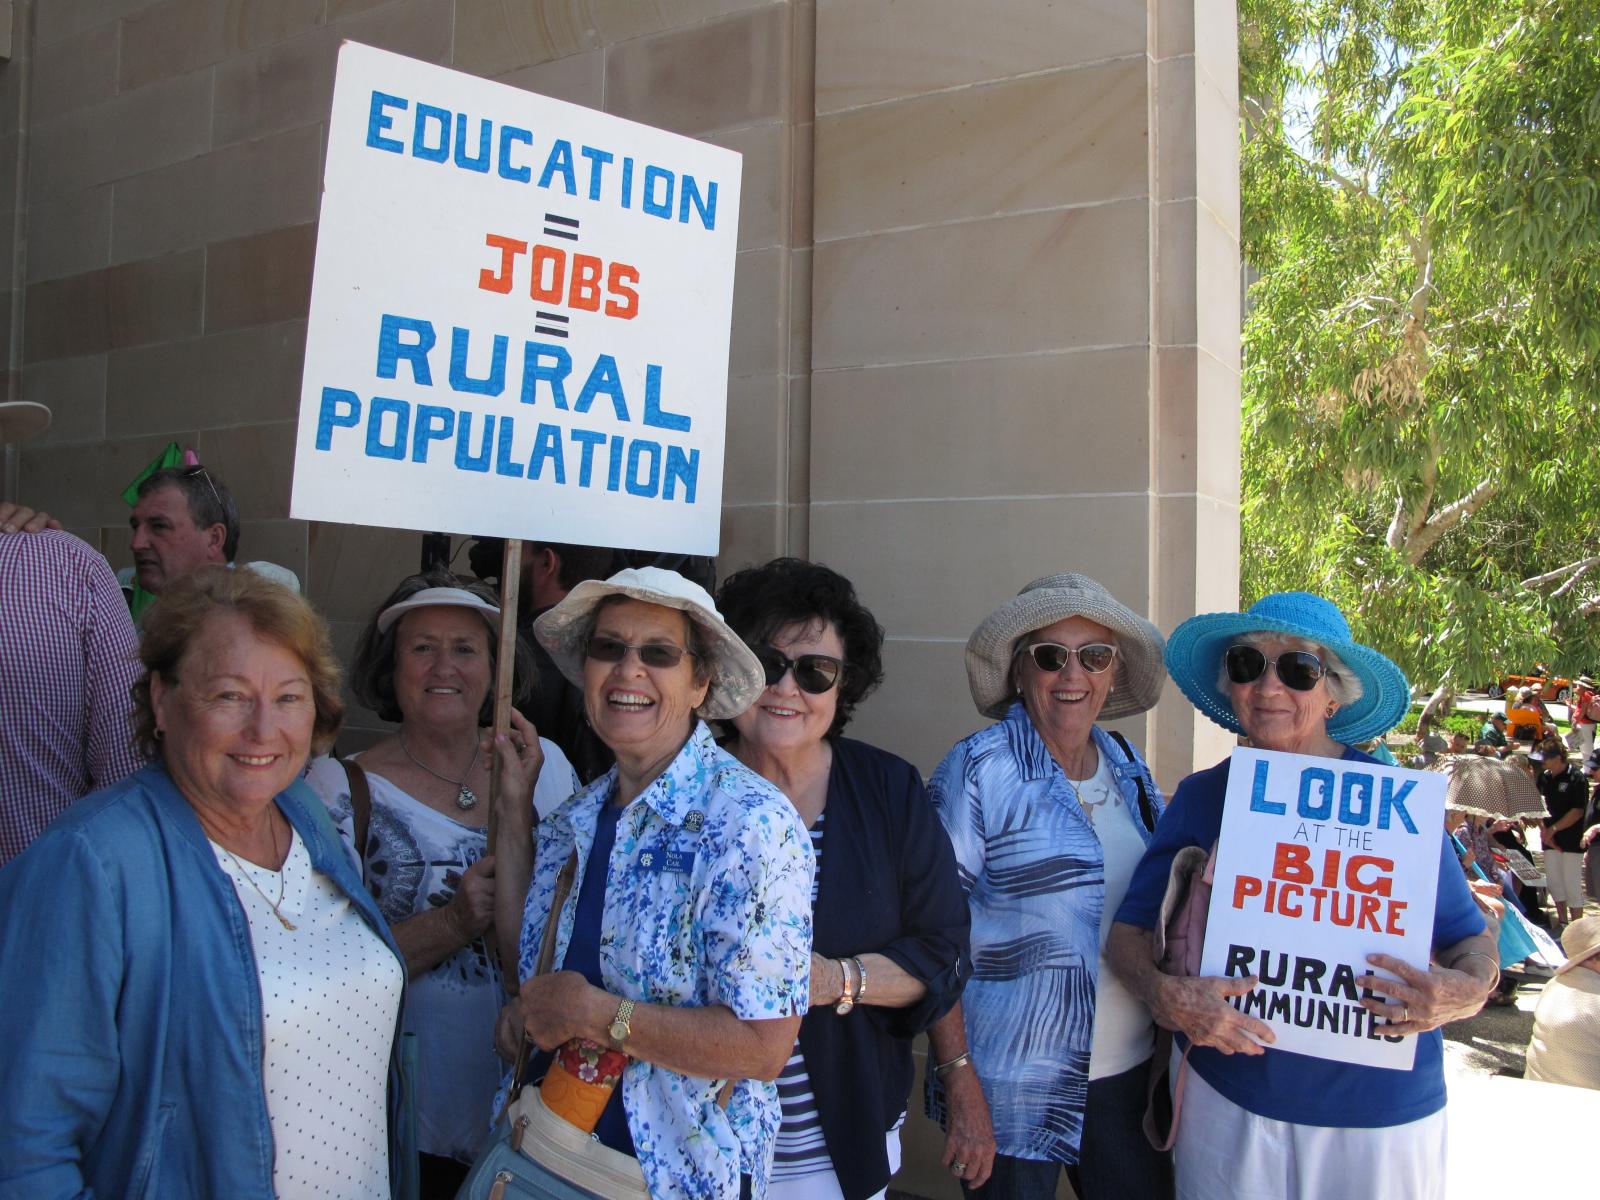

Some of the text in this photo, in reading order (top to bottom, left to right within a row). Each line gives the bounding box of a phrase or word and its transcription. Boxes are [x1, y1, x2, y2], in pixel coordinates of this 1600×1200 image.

[366, 90, 718, 231] EDUCATION
[544, 213, 580, 240] =
[479, 234, 640, 320] JOBS
[534, 311, 570, 338] =
[376, 313, 692, 432] RURAL
[315, 386, 700, 504] POPULATION
[1250, 760, 1419, 835] LOOK
[1293, 822, 1373, 851] AT THE
[1273, 842, 1394, 897] BIG
[1233, 875, 1408, 937] PICTURE
[1225, 944, 1387, 1003] RURAL
[1224, 988, 1405, 1043] MMUNITE
